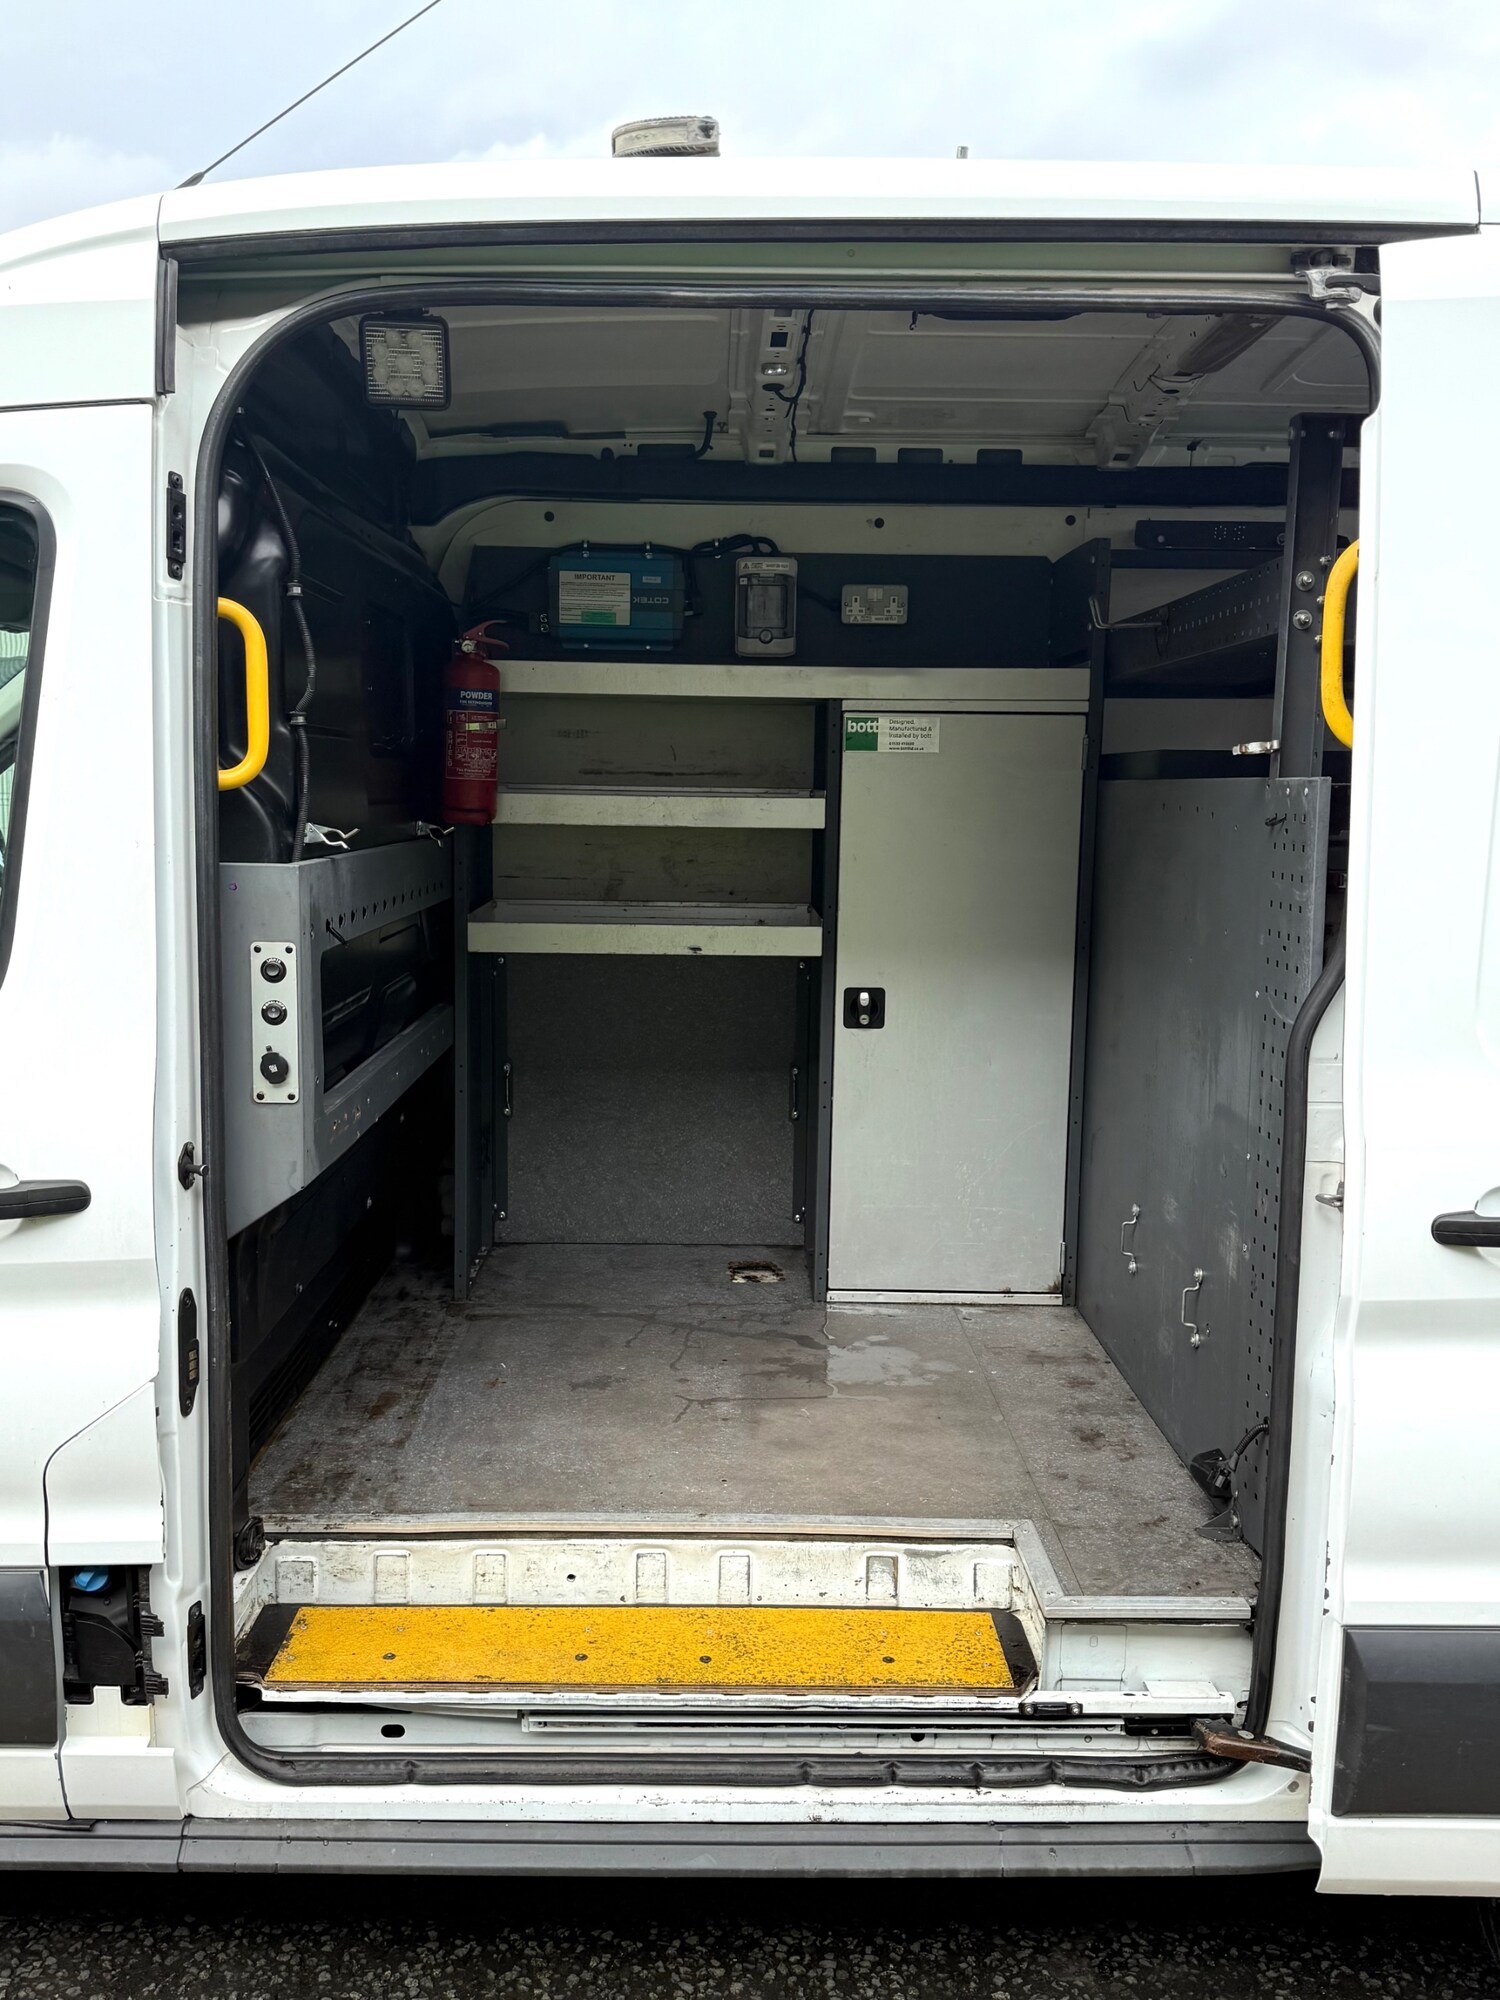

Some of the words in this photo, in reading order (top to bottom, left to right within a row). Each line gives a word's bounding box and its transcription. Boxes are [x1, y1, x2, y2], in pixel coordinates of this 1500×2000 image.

[574, 573, 616, 581] IMPORTANT
[633, 596, 669, 604] COTEK
[460, 690, 493, 700] POWDER
[847, 720, 880, 733] bott
